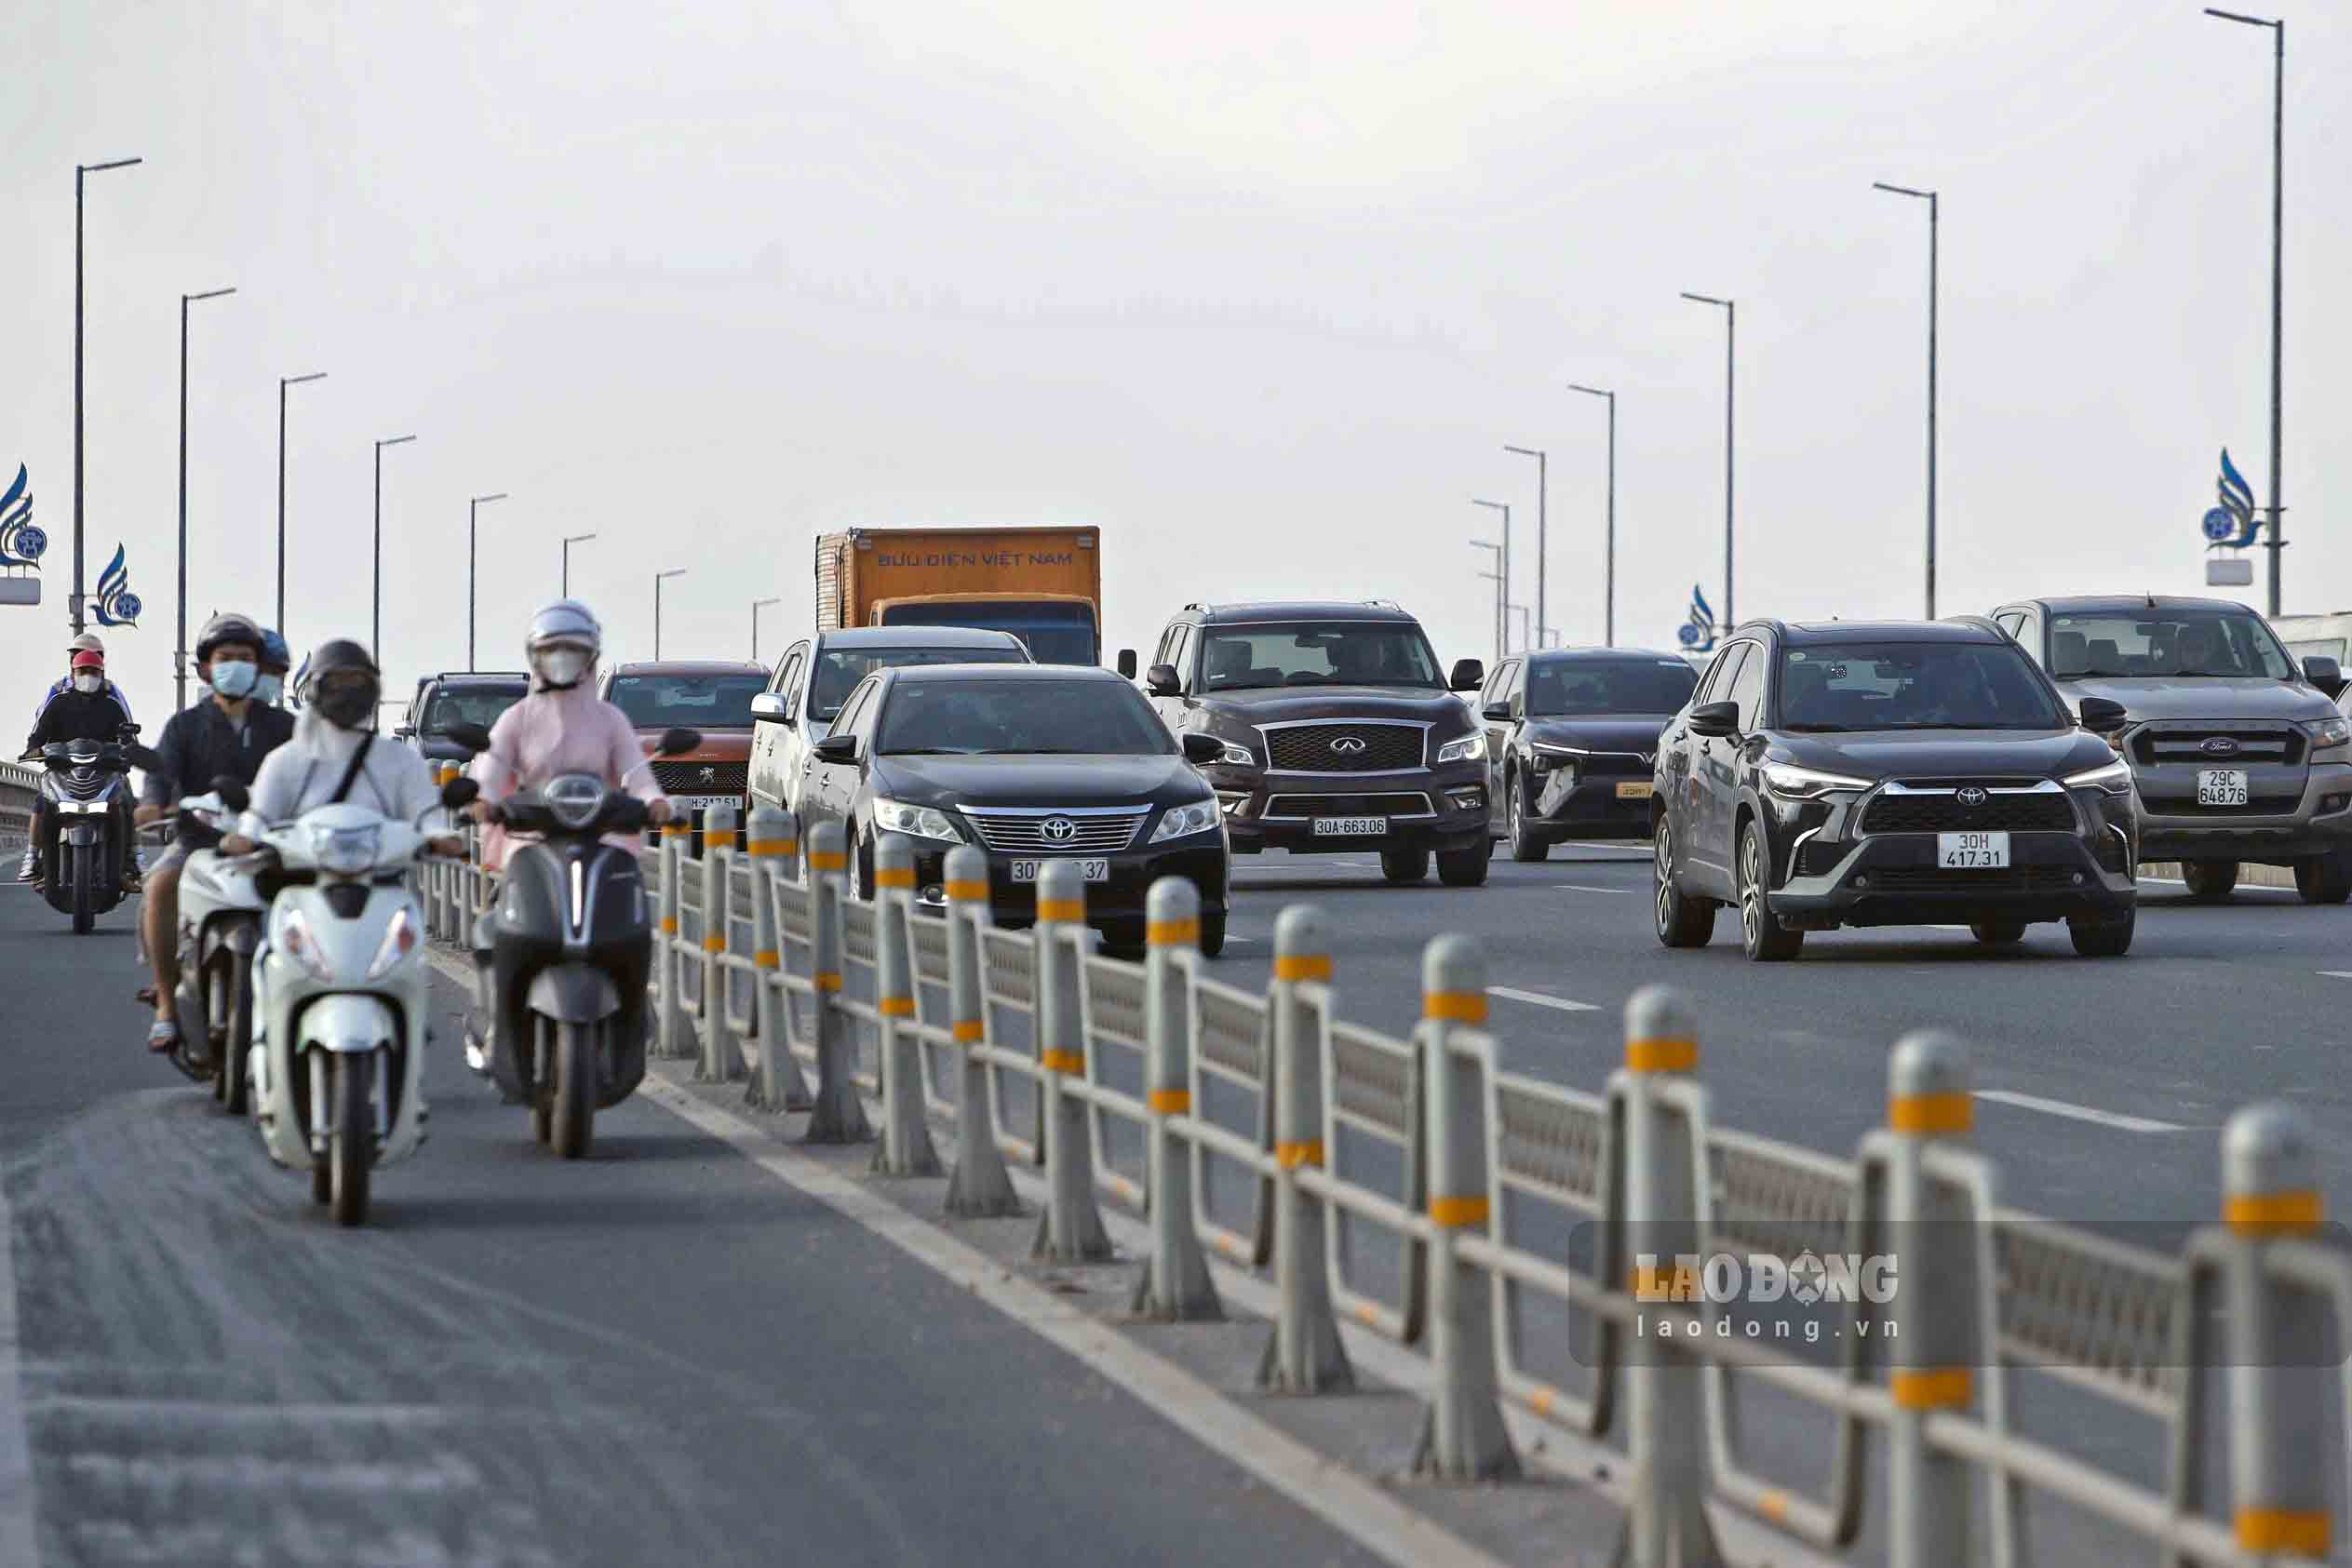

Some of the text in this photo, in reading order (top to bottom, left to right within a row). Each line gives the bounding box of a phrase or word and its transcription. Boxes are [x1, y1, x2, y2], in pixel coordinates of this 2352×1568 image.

[1028, 551, 1073, 567] NAM
[2210, 741, 2232, 752] Ford
[2211, 771, 2235, 786] 29C
[1316, 820, 1384, 834] 30A-663.06
[1958, 834, 1989, 849] 30H
[1946, 851, 2000, 865] 417.31
